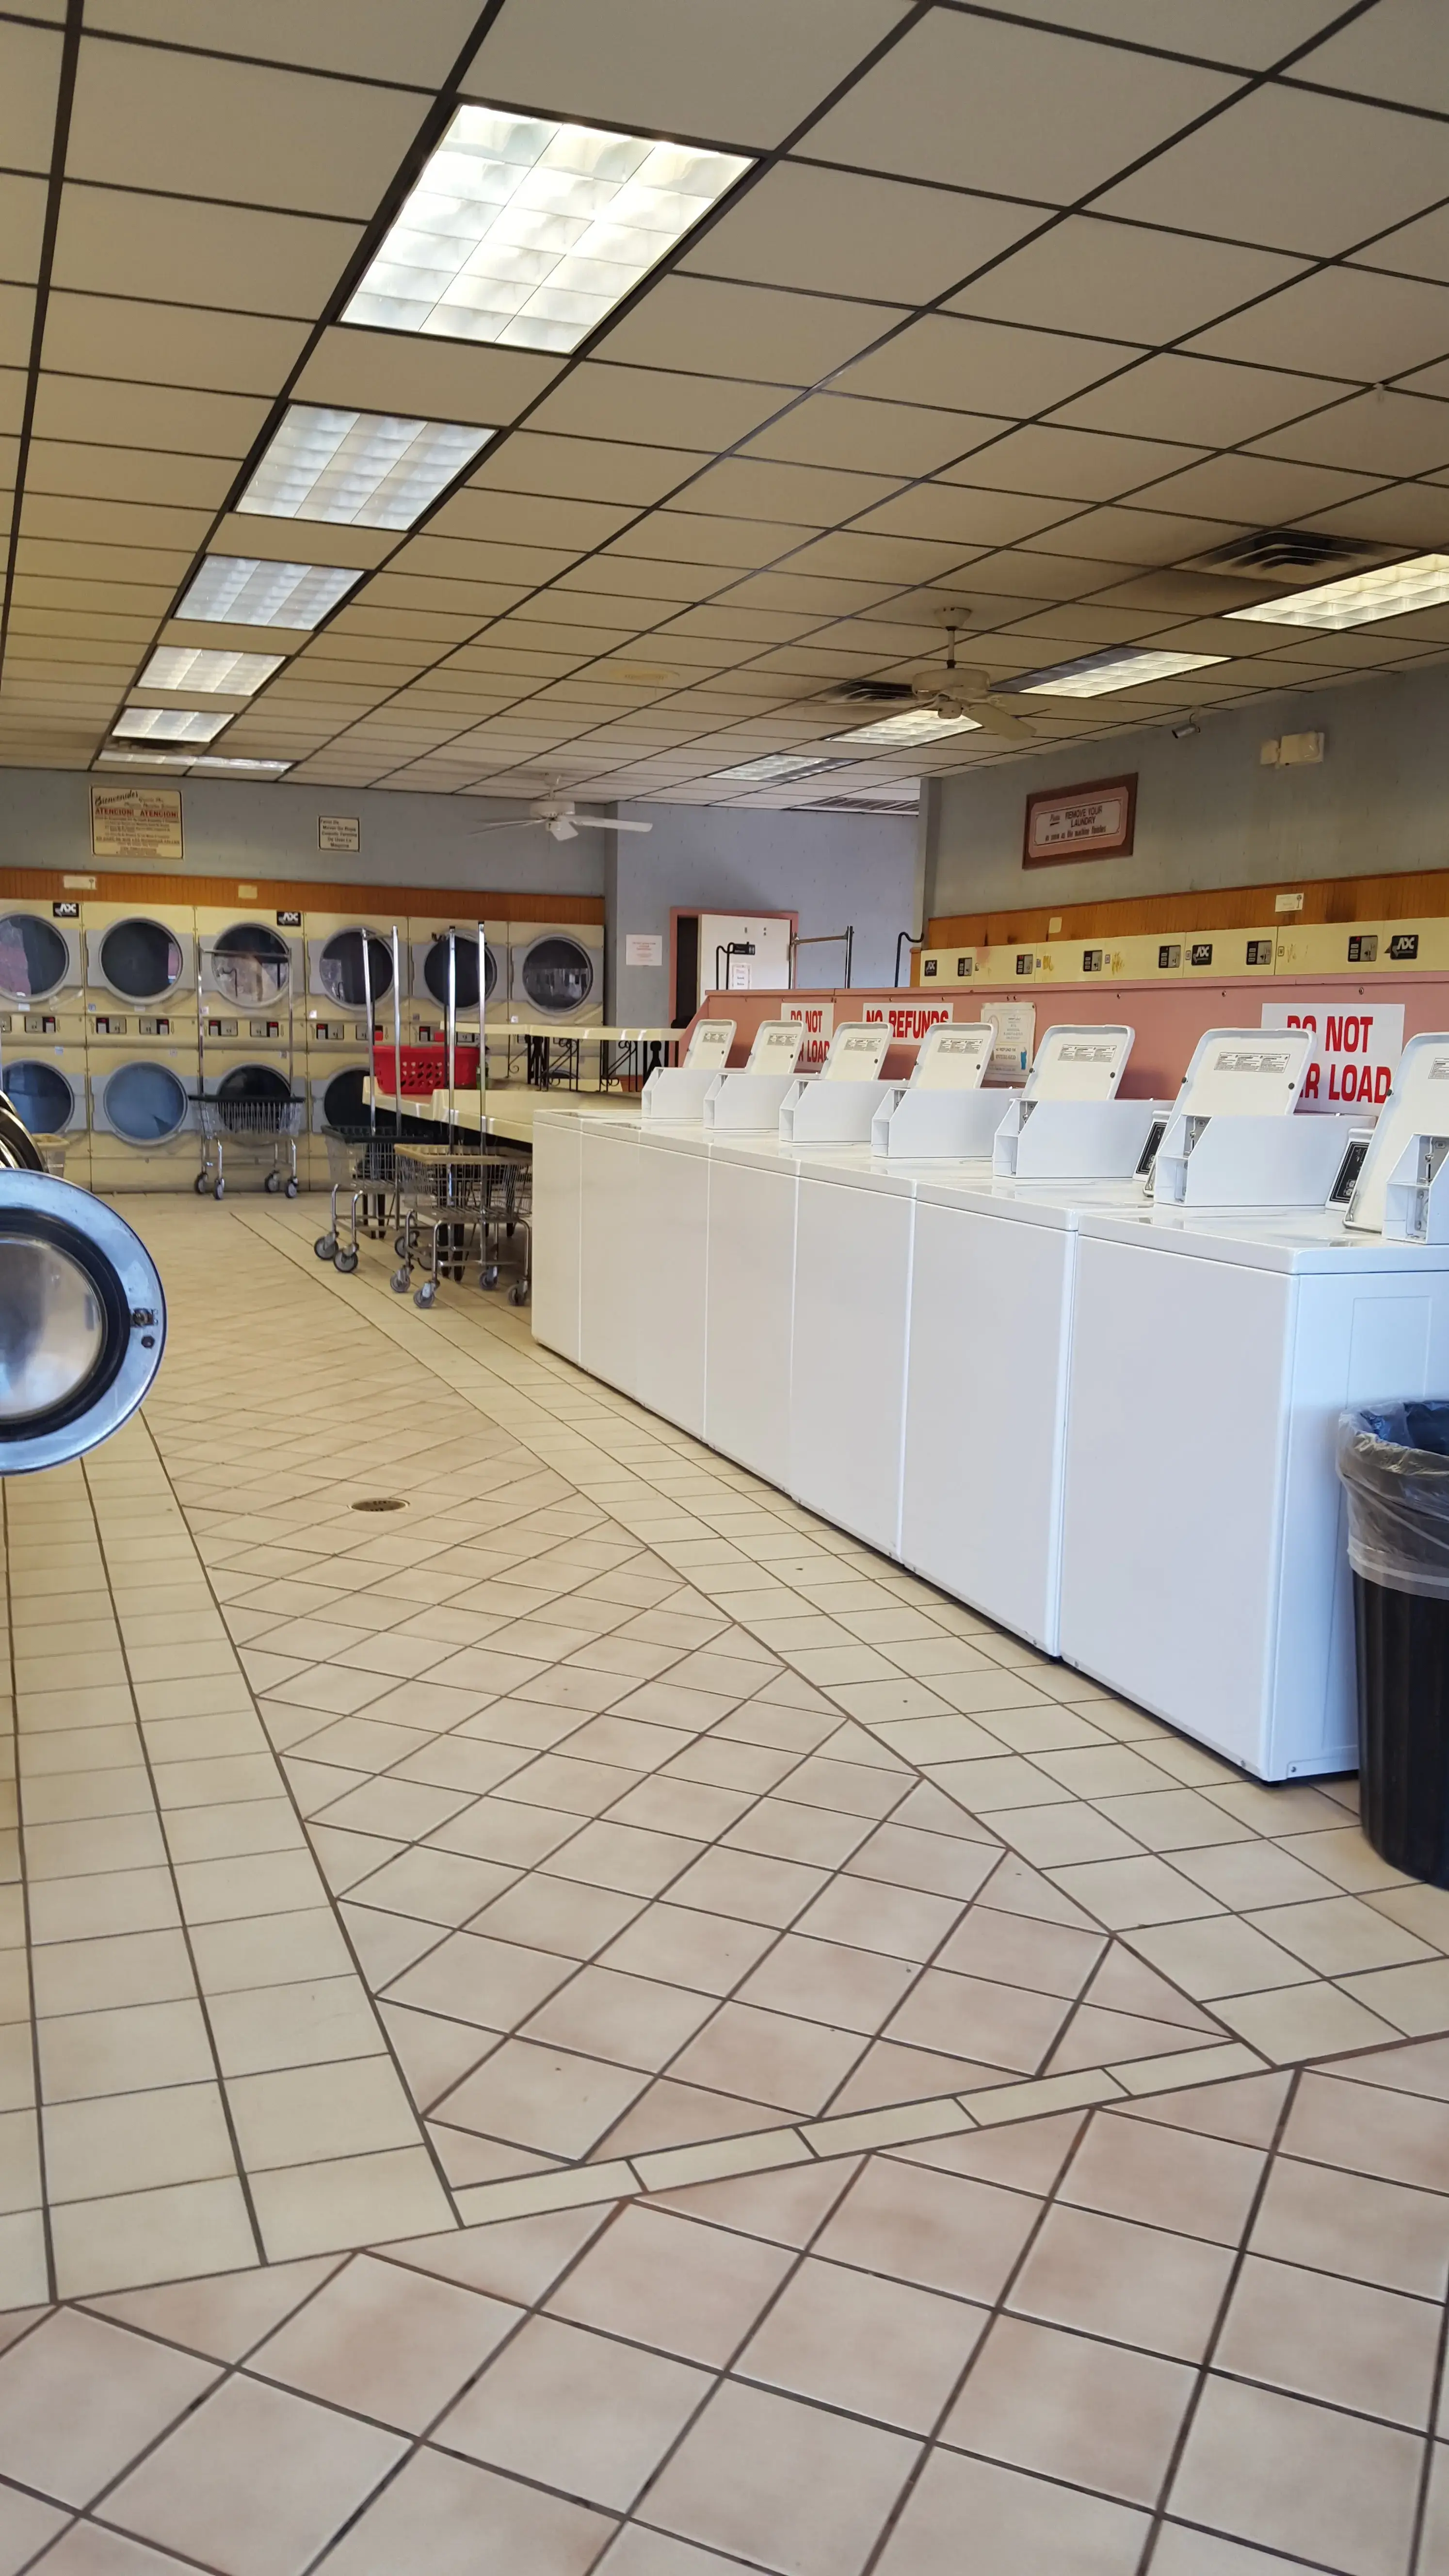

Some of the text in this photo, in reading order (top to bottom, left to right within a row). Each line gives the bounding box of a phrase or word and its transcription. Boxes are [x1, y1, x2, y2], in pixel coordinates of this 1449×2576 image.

[1065, 808, 1086, 820] REMOVE
[1088, 805, 1102, 816] YOUR
[1071, 816, 1095, 827] LAUNDRY
[805, 1011, 822, 1032] NOT
[1325, 1016, 1373, 1052] NOT
[807, 1040, 830, 1063] LOAD
[1329, 1064, 1391, 1104] LOAD
